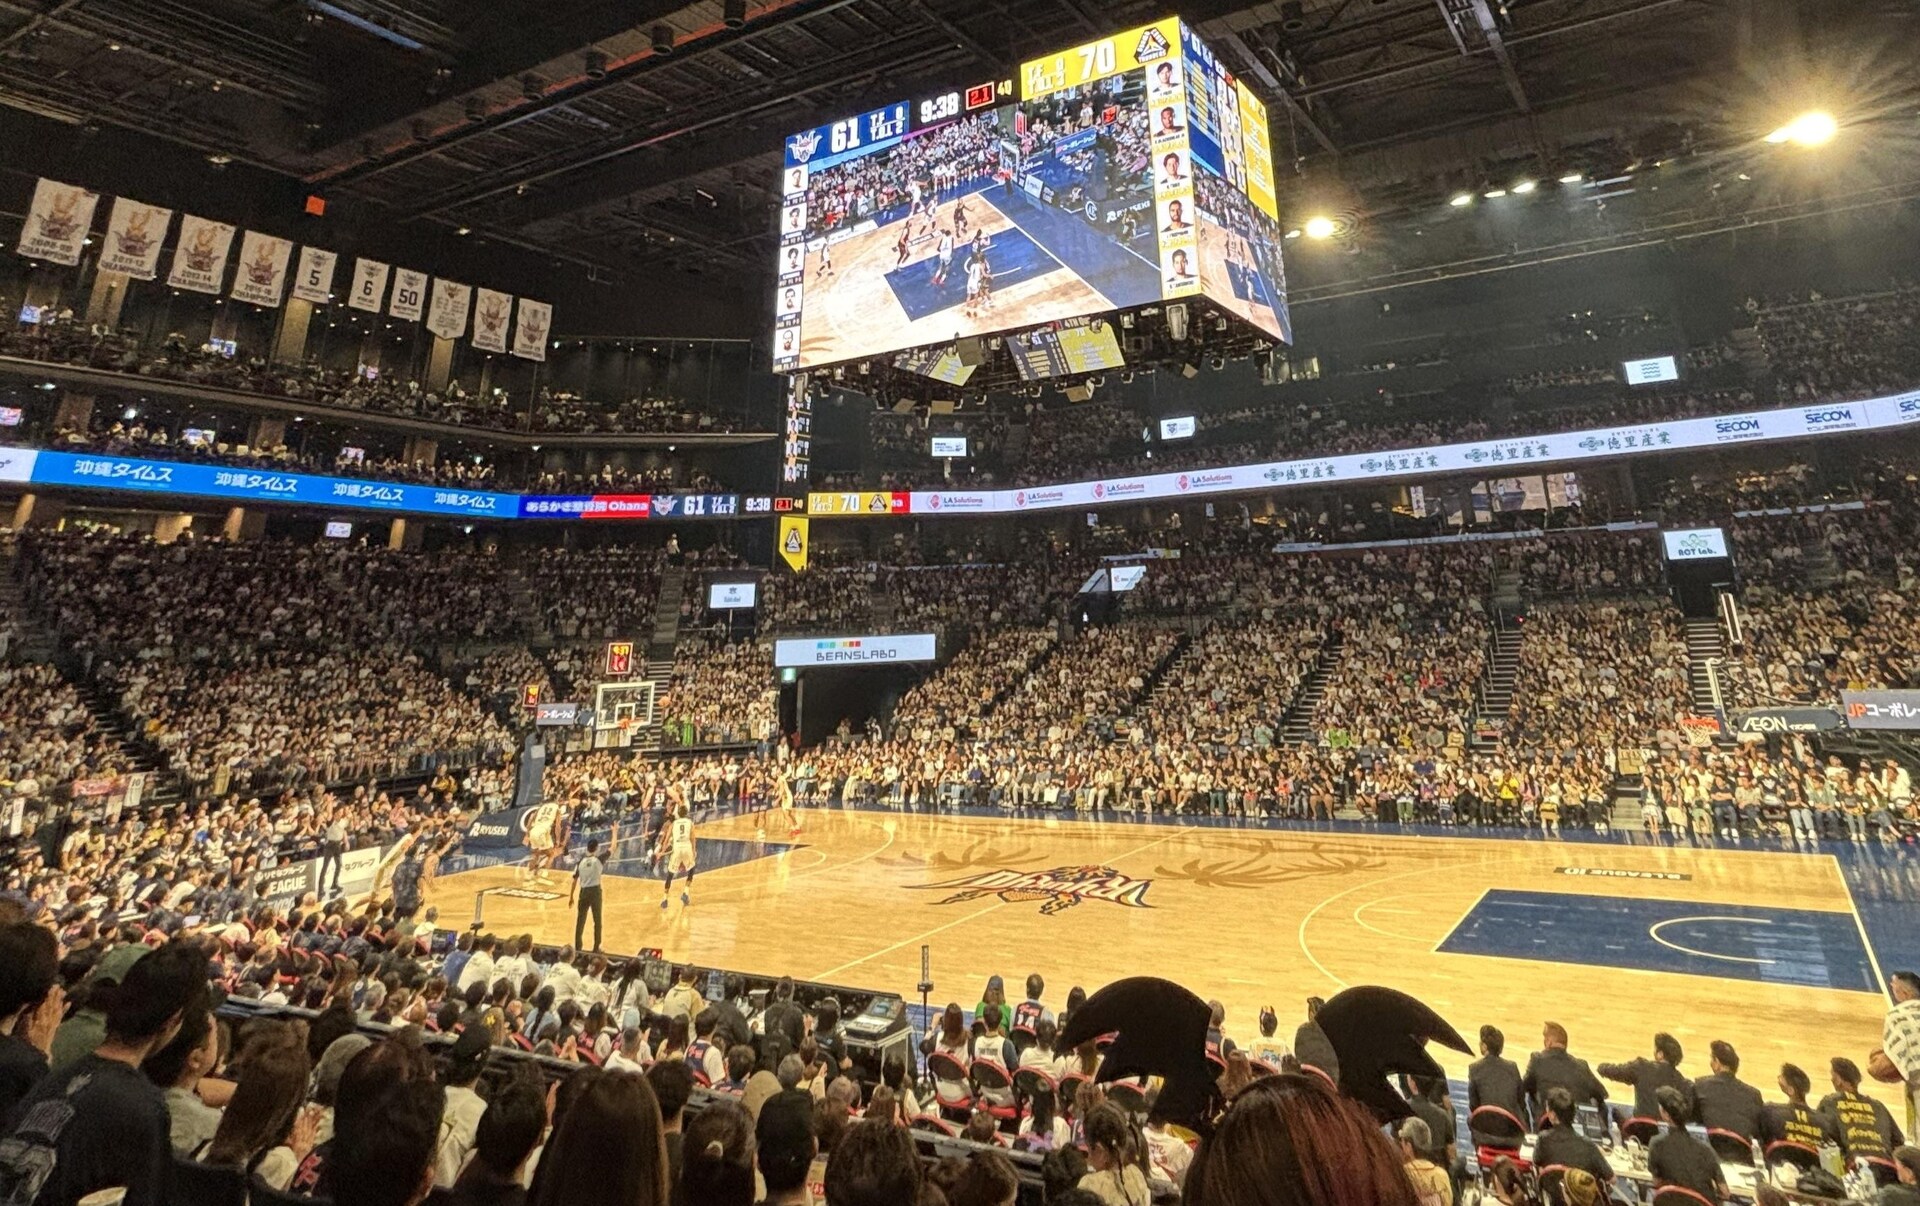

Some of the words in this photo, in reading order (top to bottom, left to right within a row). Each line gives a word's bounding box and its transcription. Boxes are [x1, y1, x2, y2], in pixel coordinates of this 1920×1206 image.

[1079, 39, 1116, 80] 70
[921, 92, 958, 123] 9:38
[831, 118, 860, 153] 61
[309, 270, 320, 286] 5
[363, 280, 373, 296] 6
[399, 288, 419, 307] 50
[1805, 409, 1852, 424] SECOM
[1716, 419, 1760, 433] SECOM
[73, 459, 174, 482] 沖縄タイムス
[1202, 474, 1232, 483] Solutions
[214, 472, 298, 492] 沖縄タイムス
[1116, 483, 1145, 491] Solutions
[333, 482, 405, 501] 沖縄タイムス
[1037, 491, 1063, 499] Solutions
[434, 492, 496, 509] 沖縄タイムス
[608, 500, 649, 511] Ohana
[683, 495, 706, 515] 61
[745, 498, 771, 512] 9:38
[840, 494, 860, 512] 70
[954, 496, 983, 504] Solutions
[816, 649, 897, 661] BEANSLABO
[1847, 702, 1920, 719] JPコーポレ
[479, 825, 509, 835] RYUSEKI
[679, 824, 685, 835] 9
[344, 858, 377, 872] なグループ
